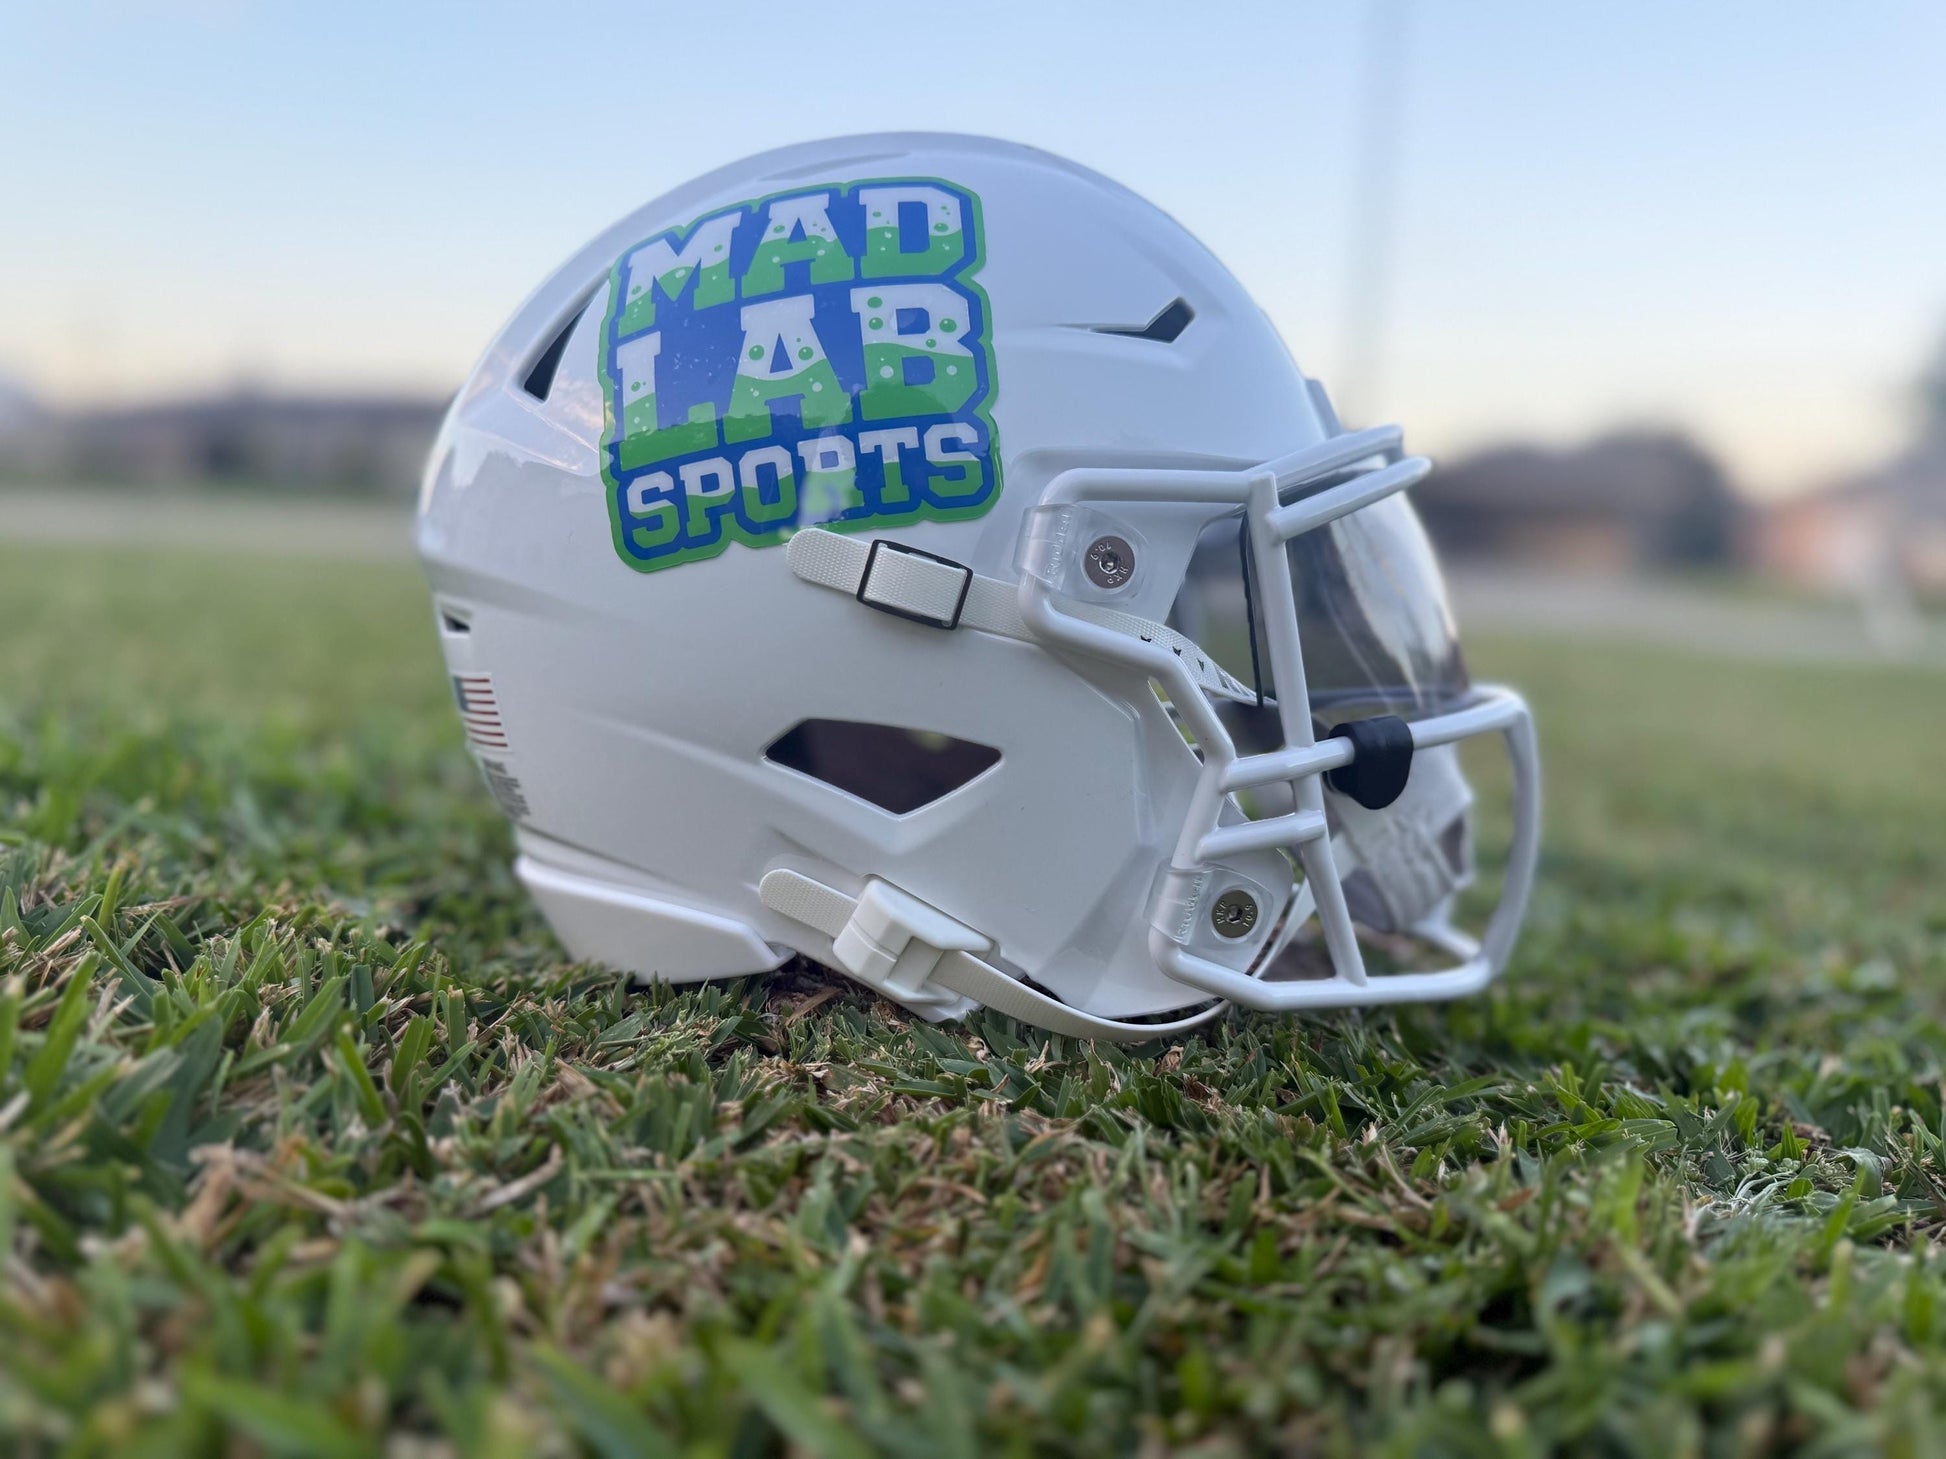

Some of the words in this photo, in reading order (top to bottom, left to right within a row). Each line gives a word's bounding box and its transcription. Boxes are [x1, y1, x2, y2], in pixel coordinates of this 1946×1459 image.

[618, 186, 965, 337] MAD
[616, 283, 979, 471] LAB
[626, 422, 984, 548] SPORTS
